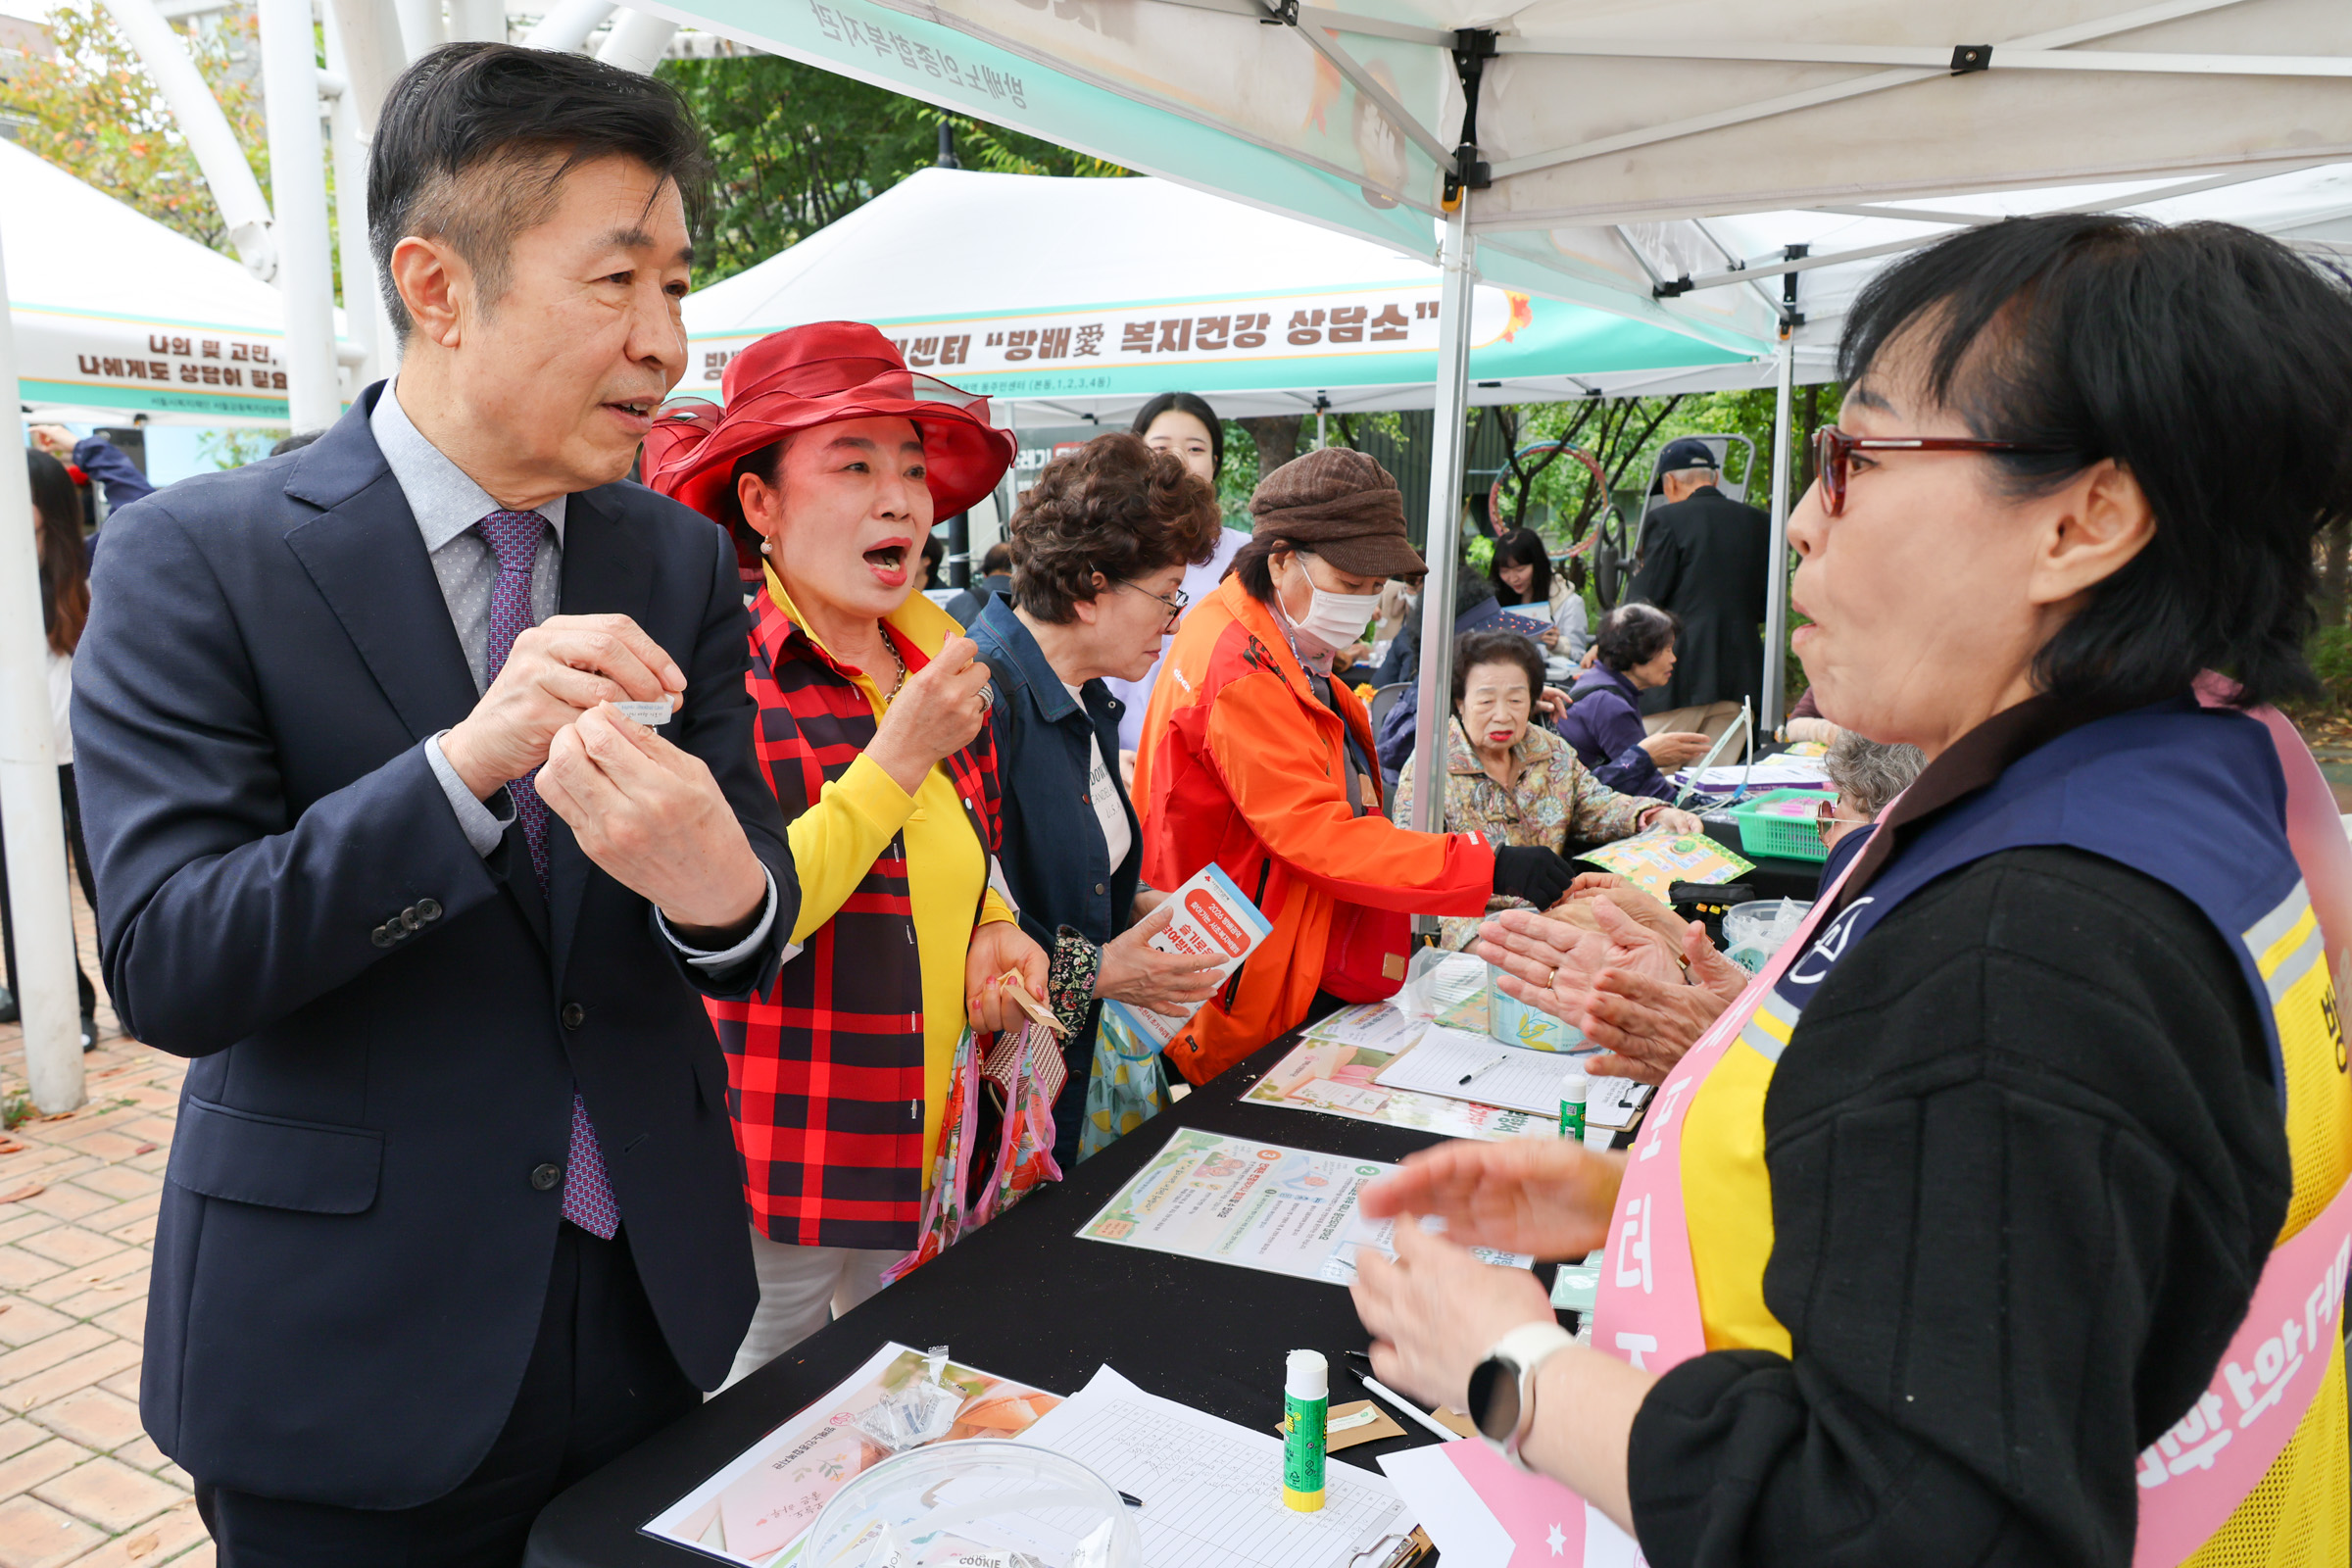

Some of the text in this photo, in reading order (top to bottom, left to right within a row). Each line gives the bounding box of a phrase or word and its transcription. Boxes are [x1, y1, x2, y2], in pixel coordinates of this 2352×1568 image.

[149, 334, 192, 357] 나의
[231, 341, 277, 366] 고민,
[892, 334, 970, 368] 센터
[1121, 313, 1271, 355] 복지건강
[1289, 300, 1440, 347] 상담소"
[78, 354, 171, 382] 나에게도
[180, 363, 243, 386] 상담이
[1016, 447, 1053, 470] 레기
[1207, 903, 1225, 920] 2026
[1189, 901, 1212, 924] 찾아가는
[1207, 920, 1242, 955] 서초복지박람회
[771, 1423, 836, 1472] 방배노인종합복지관
[958, 1555, 1002, 1568] COOKIE
